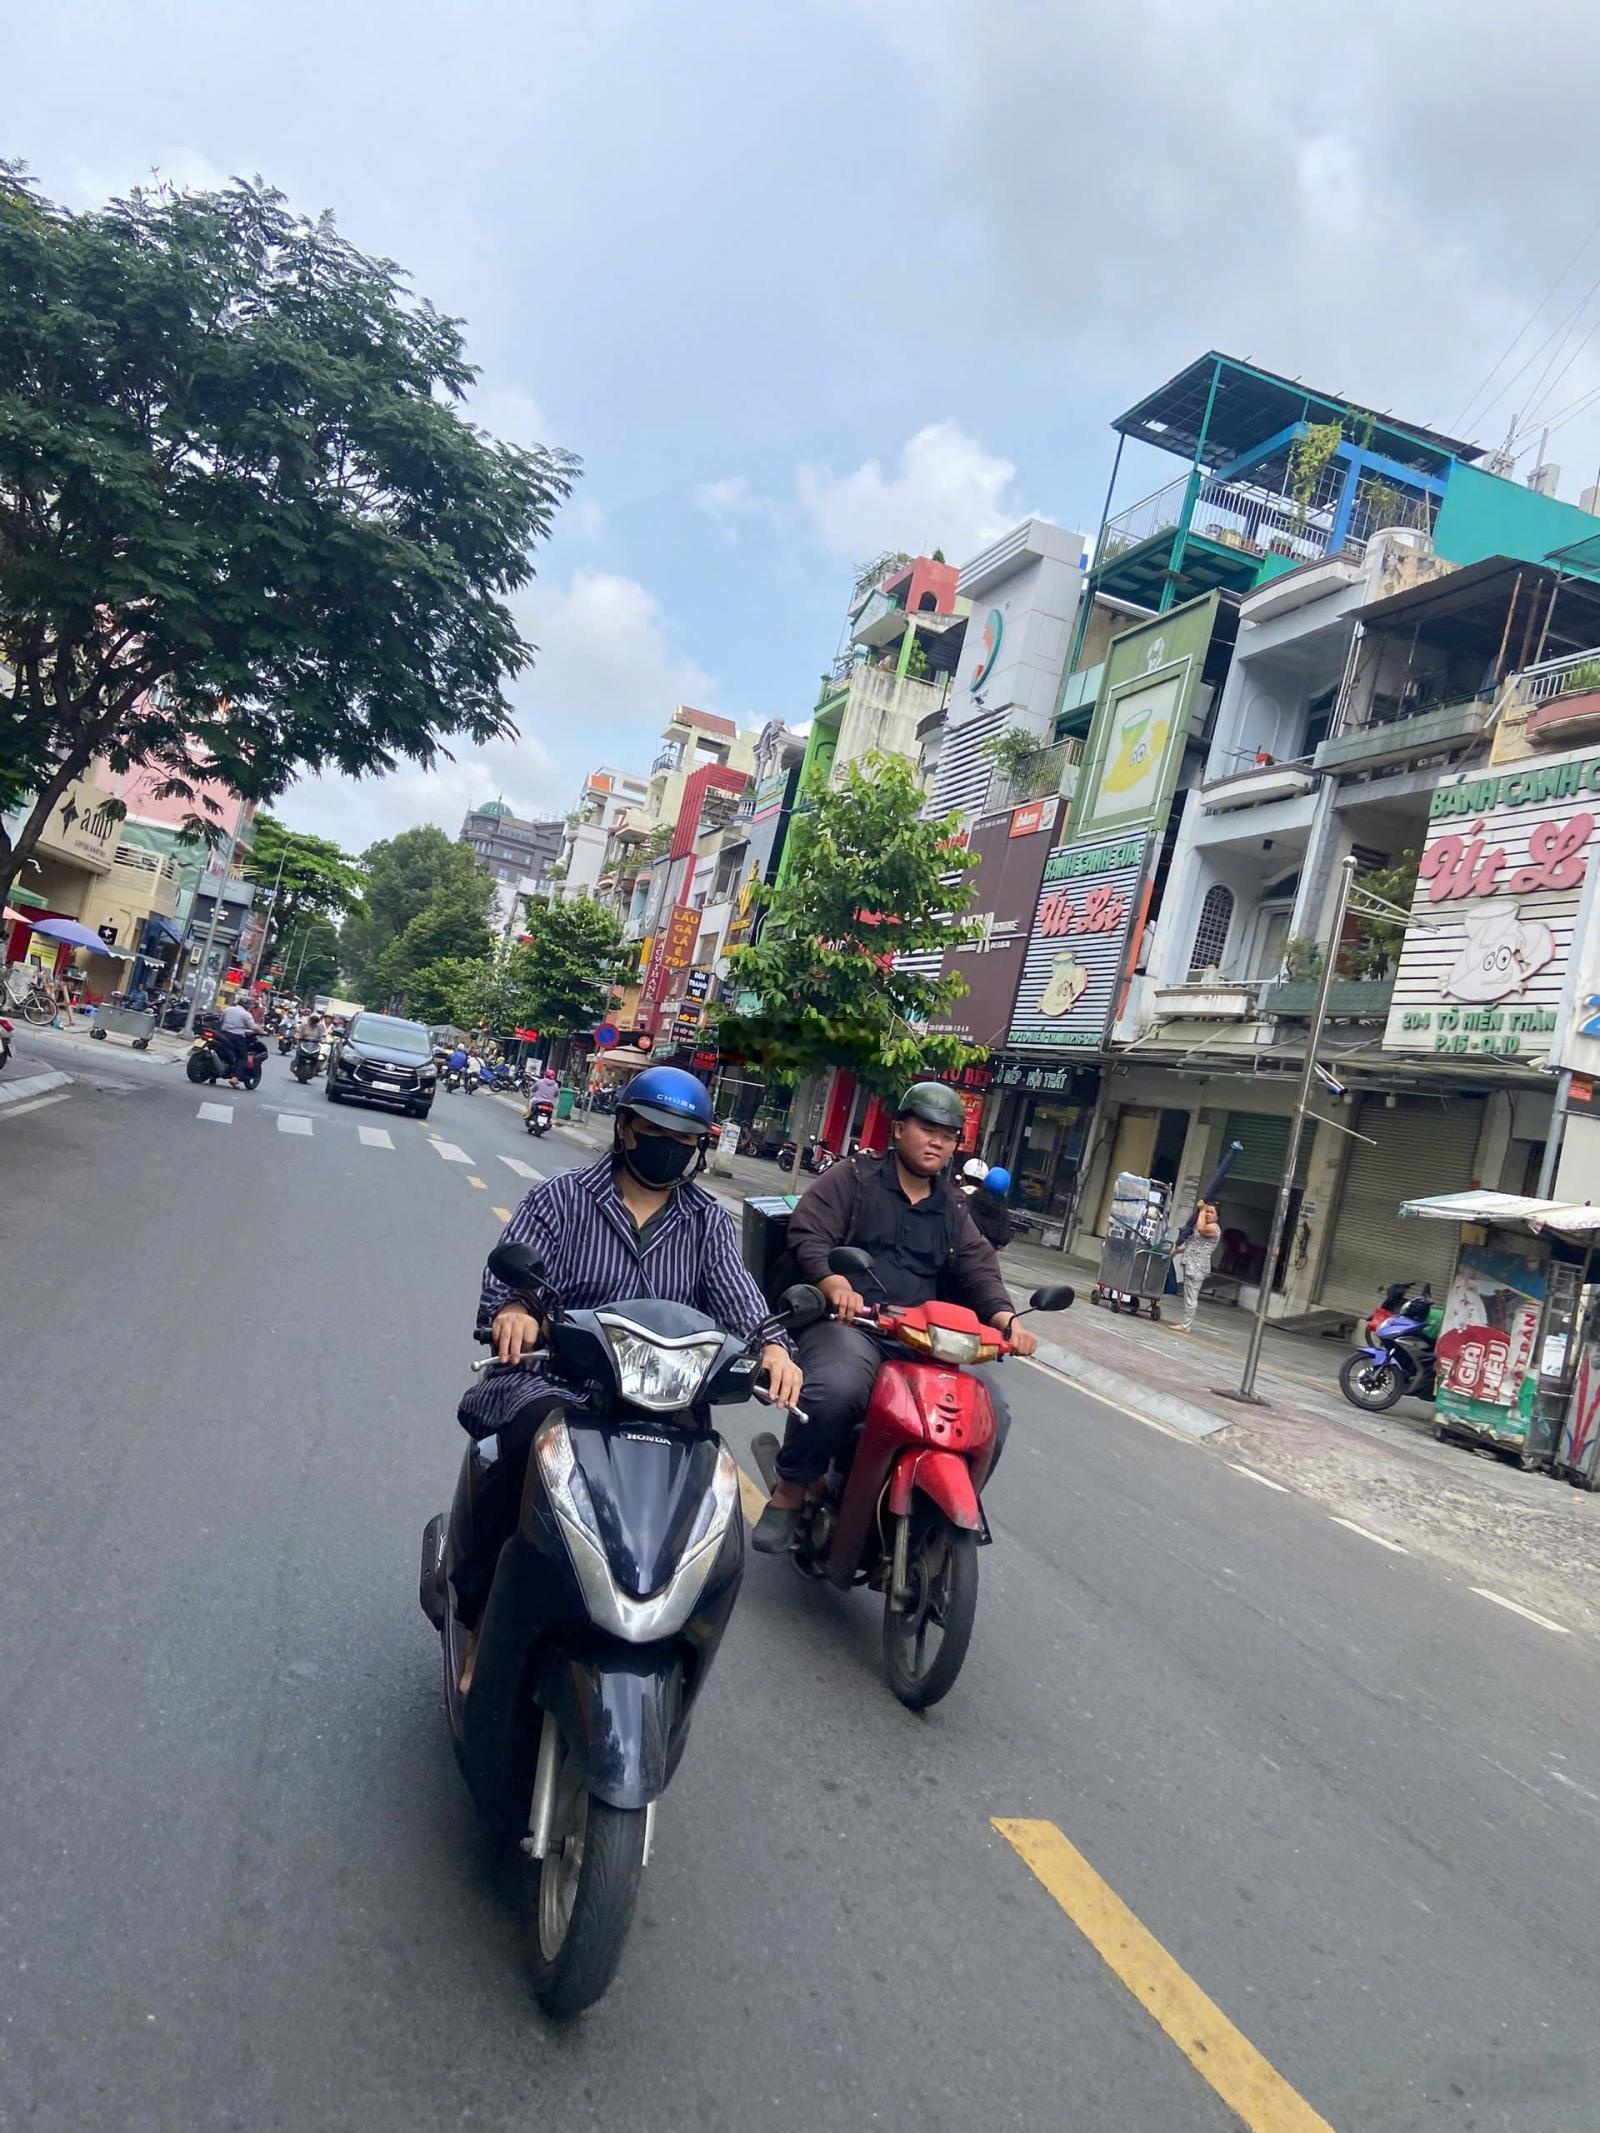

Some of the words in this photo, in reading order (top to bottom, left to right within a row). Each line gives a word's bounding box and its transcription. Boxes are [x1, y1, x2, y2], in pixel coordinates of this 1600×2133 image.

[1430, 774, 1501, 818] BÁNH
[1503, 761, 1584, 806] CANH
[1420, 817, 1507, 903] Út
[1039, 887, 1075, 938] Út
[1075, 883, 1127, 939] Lệ
[1402, 1012, 1431, 1031] 204
[1462, 1003, 1505, 1032] HIẾN
[1435, 1034, 1469, 1053] P.15
[626, 1433, 672, 1446] HONDA
